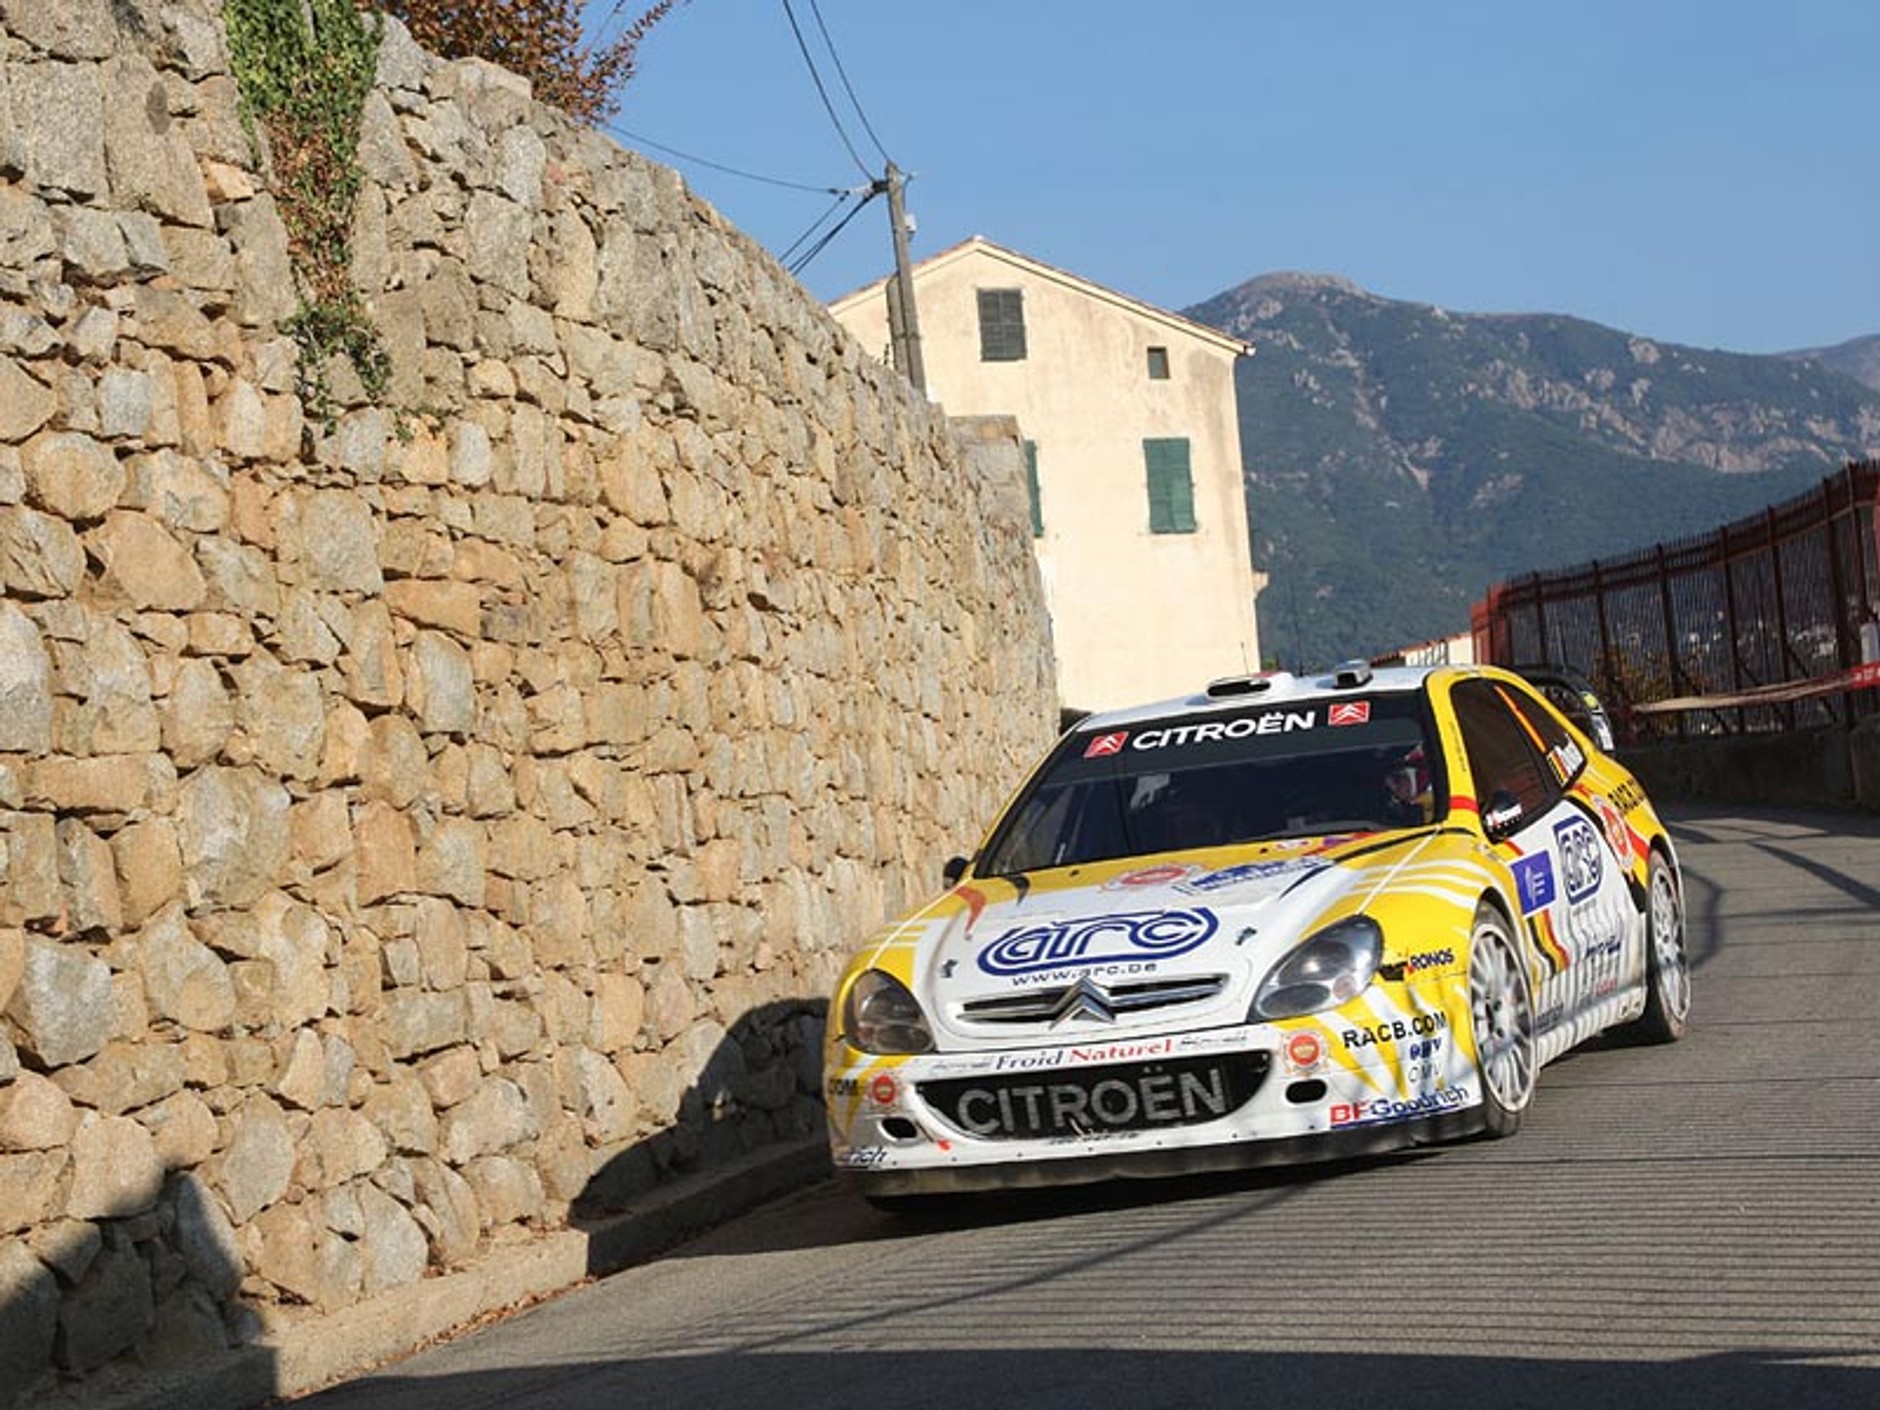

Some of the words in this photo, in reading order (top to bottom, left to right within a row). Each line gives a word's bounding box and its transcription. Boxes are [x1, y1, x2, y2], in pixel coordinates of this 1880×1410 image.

[1132, 711, 1316, 750] CITROËN
[978, 907, 1219, 976] arc
[1342, 1012, 1447, 1048] RACB.COM
[995, 1050, 1063, 1071] Froid
[1069, 1038, 1173, 1063] Naturel
[957, 1065, 1227, 1134] CITROËN
[1330, 1084, 1469, 1123] BFGoodrich
